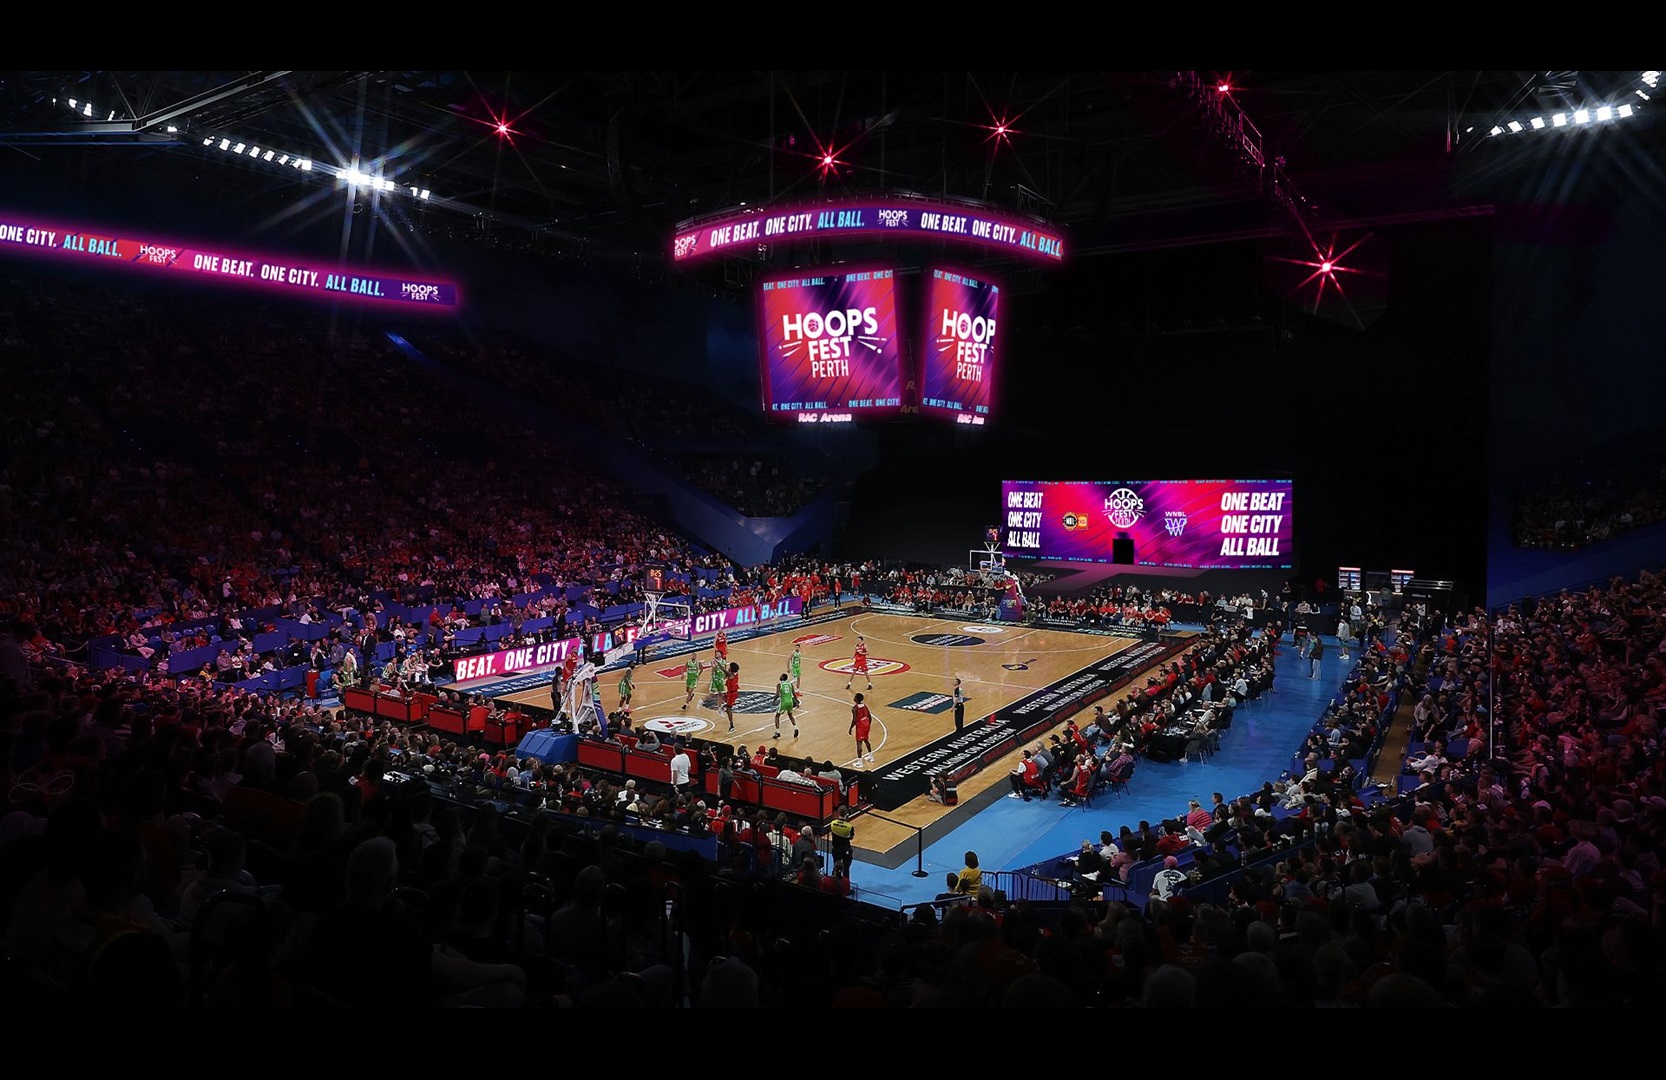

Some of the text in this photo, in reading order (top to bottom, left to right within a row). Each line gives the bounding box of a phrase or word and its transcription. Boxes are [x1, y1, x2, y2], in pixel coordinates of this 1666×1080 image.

[878, 210, 907, 220] HOOPS
[886, 219, 899, 227] FEST
[710, 211, 865, 247] ONE BEAT. ONE CITY. ALL BALL.
[920, 212, 941, 230] ONE
[941, 215, 967, 233] BEAT.
[972, 220, 992, 237] ONE
[992, 224, 1016, 243] CITY.
[1020, 231, 1036, 249] ALL
[0, 225, 122, 257] ONE CITY. ALL BALL.
[140, 245, 176, 258] HOOPS
[149, 254, 166, 263] FEST
[194, 254, 384, 296] ONE BEAT. ONE CITY. ALL BALL.
[402, 283, 439, 295] HOOPS
[411, 292, 429, 300] FEST
[782, 307, 879, 340] HOOPS
[942, 308, 996, 345] HOOP
[808, 335, 852, 361] FEST
[957, 341, 988, 364] FEST
[812, 359, 849, 378] PERTH
[956, 362, 982, 382] PERTH
[798, 412, 852, 422] RAC Arena
[1007, 491, 1044, 508] ONE BEAT
[1104, 498, 1143, 510] HOOPS
[1220, 492, 1286, 511] ONE BEAT
[1007, 511, 1042, 528] ONE CITY
[1114, 509, 1133, 518] FEST
[1220, 515, 1284, 533] ONE CITY
[1006, 531, 1021, 547] ALL
[1021, 531, 1040, 548] BALL
[1219, 537, 1280, 556] ALL BALL
[695, 612, 729, 633] CITY.
[735, 607, 756, 625] ALL
[456, 640, 570, 681] BEAT. ONE CITY
[1012, 692, 1060, 715] WESTERN
[882, 748, 952, 781] WESTERN
[947, 719, 1011, 750] AUSTRALIA
[922, 753, 971, 776] WALKING
[964, 745, 984, 754] ON
